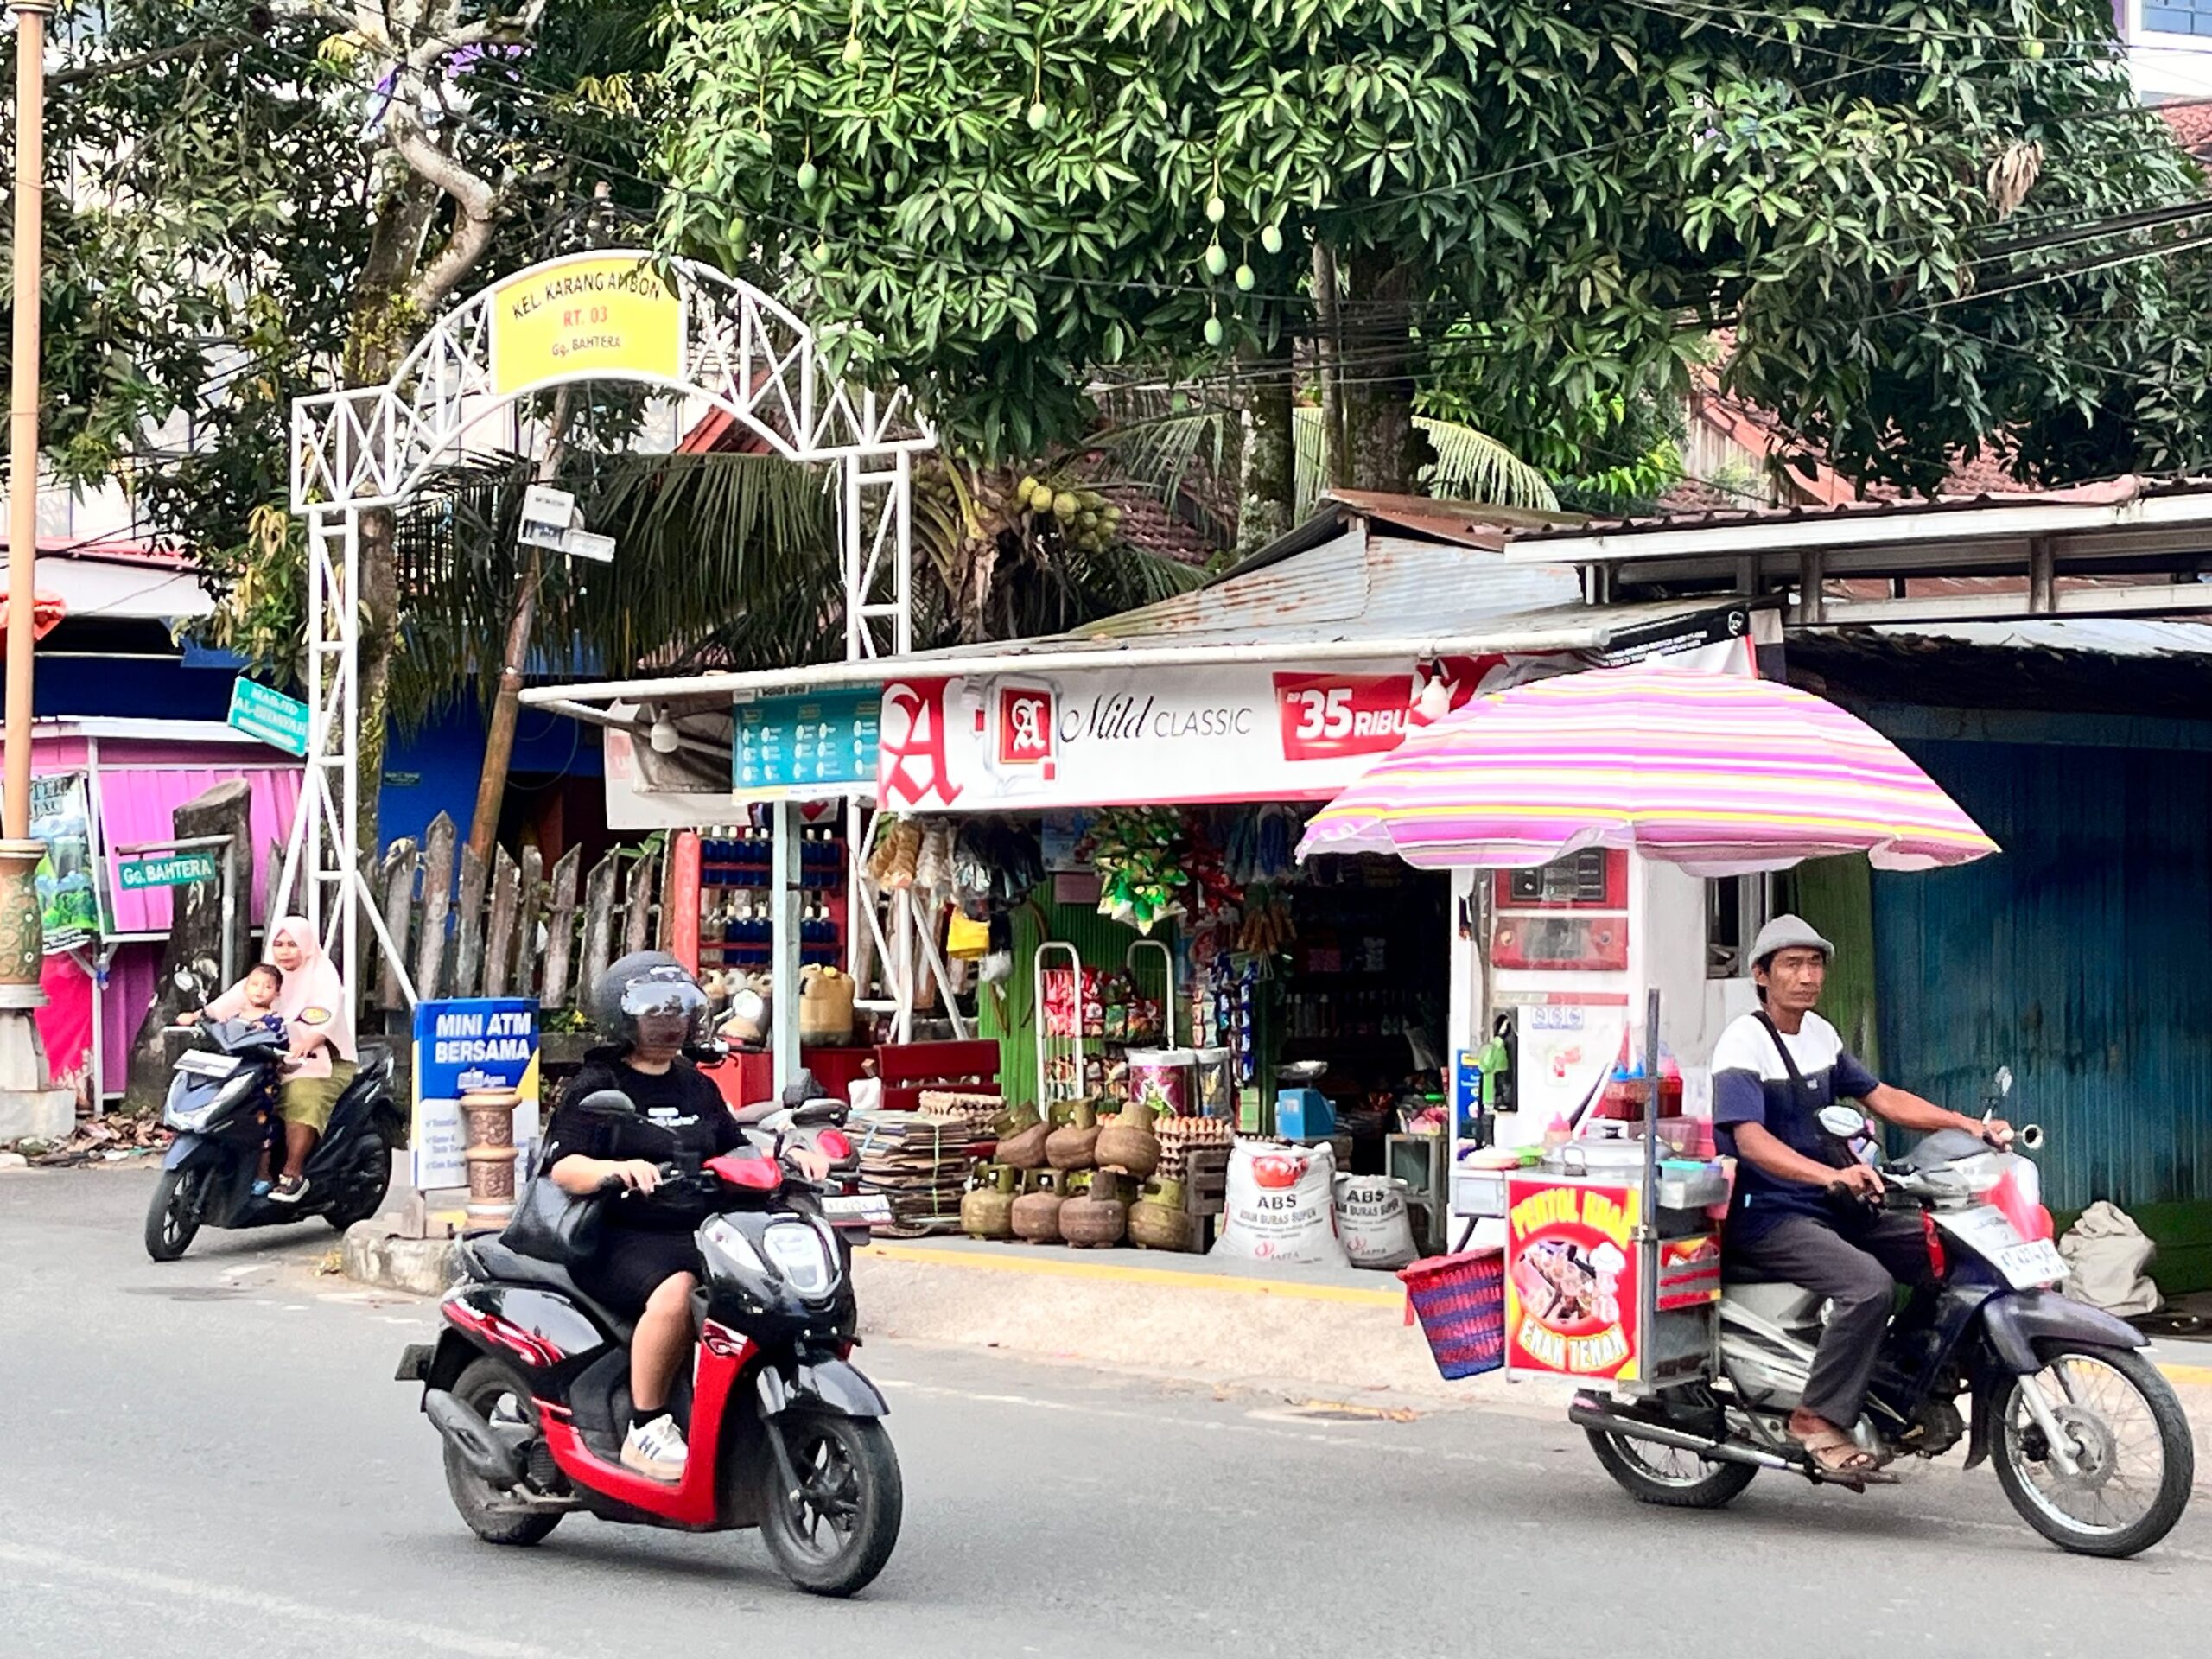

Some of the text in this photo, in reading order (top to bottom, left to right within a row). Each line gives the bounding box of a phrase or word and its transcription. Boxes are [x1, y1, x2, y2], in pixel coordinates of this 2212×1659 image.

[512, 292, 542, 320] KEL.
[545, 274, 604, 300] KARANG
[563, 305, 608, 327] RT. 03
[572, 335, 620, 350] BAHTERA
[1060, 692, 1254, 743] Mild CLASSIC
[144, 859, 213, 882] BAHTERA
[435, 1012, 532, 1037] MINI ATM
[435, 1039, 531, 1064] BERSAMA
[1257, 1193, 1297, 1211] ABS
[1347, 1189, 1385, 1204] ABS
